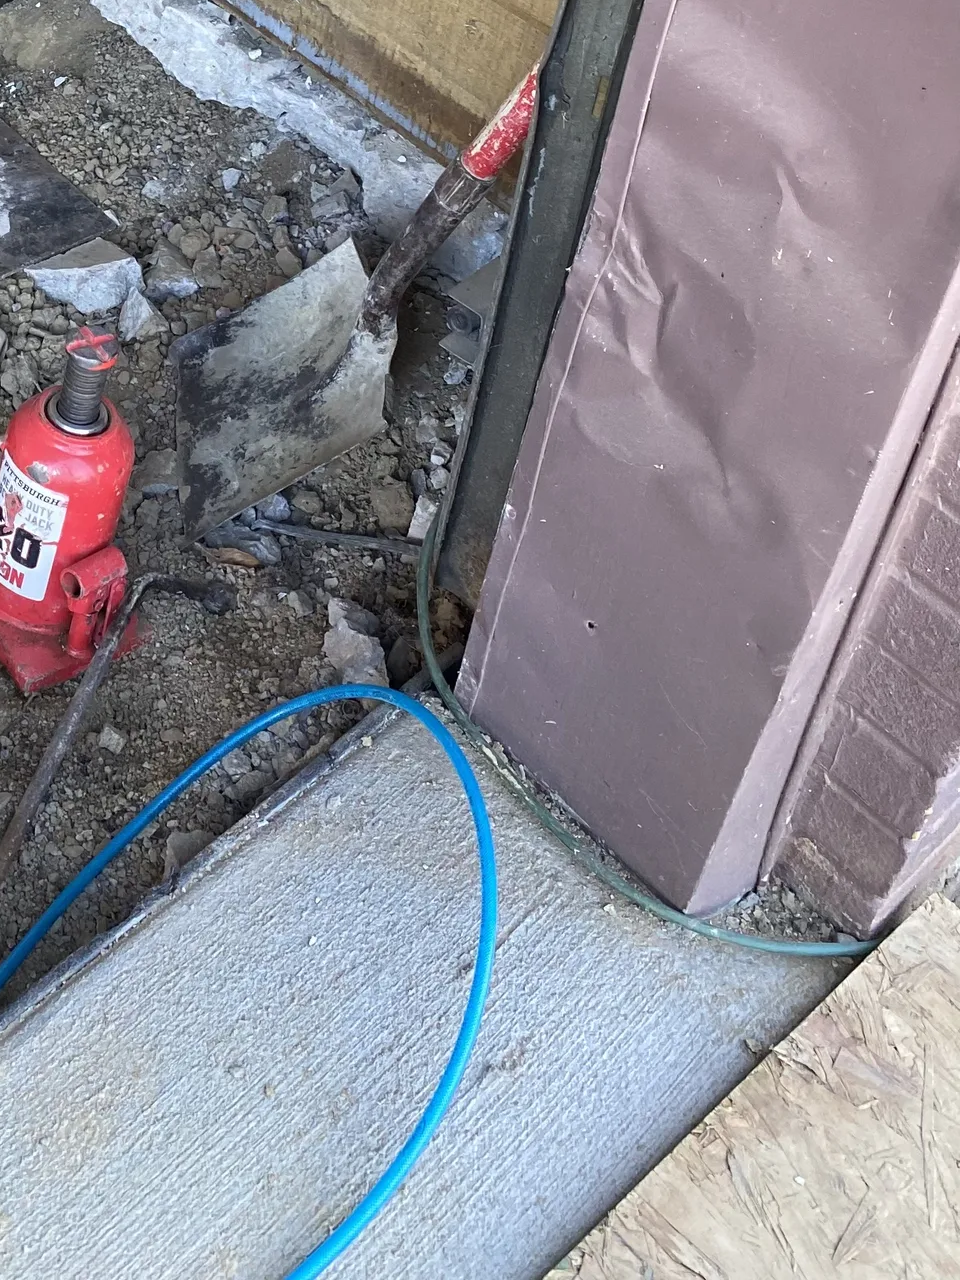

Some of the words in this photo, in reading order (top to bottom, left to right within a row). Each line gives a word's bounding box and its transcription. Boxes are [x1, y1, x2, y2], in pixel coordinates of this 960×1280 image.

[4, 459, 60, 507] PITTSBURGH
[25, 499, 54, 520] DUTY
[24, 512, 55, 531] JACK
